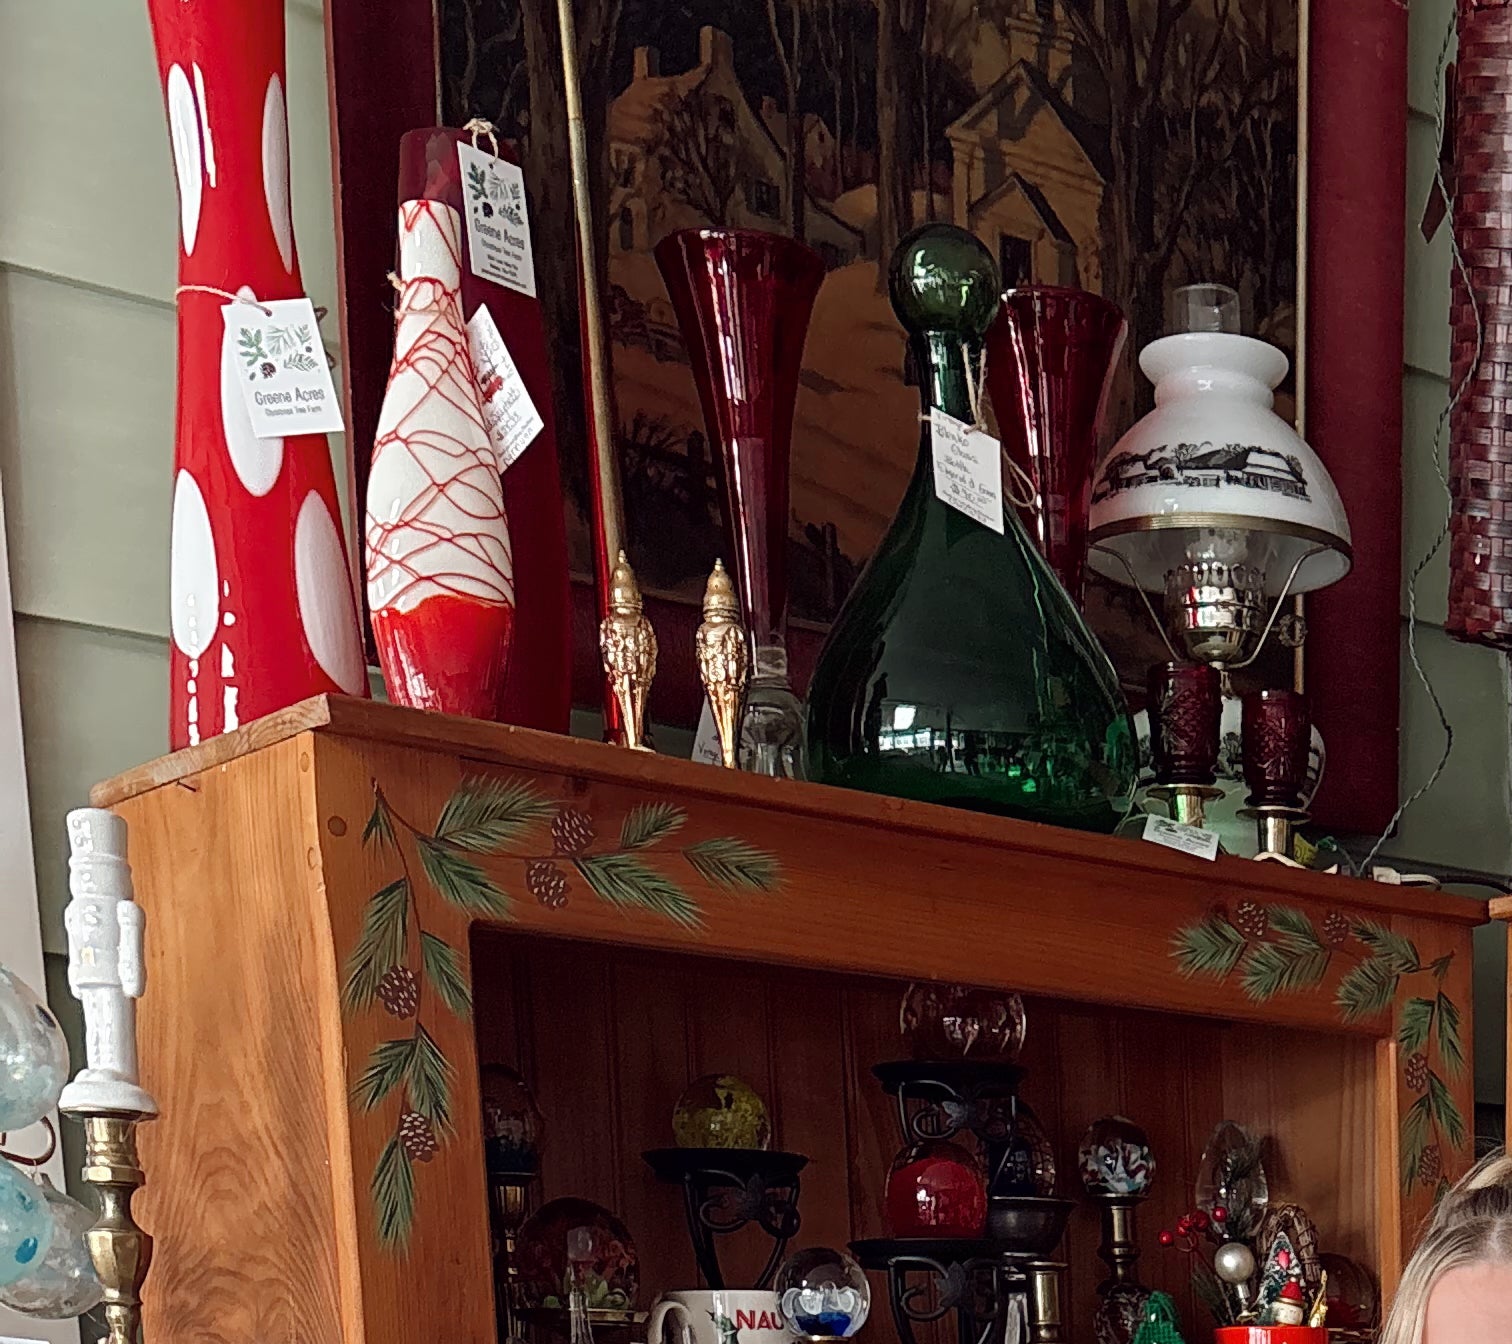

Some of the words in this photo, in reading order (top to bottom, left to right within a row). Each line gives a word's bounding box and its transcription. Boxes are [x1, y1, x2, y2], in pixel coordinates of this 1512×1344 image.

[255, 389, 292, 405] Greene
[295, 387, 325, 403] Acres
[736, 1309, 785, 1330] NAU
